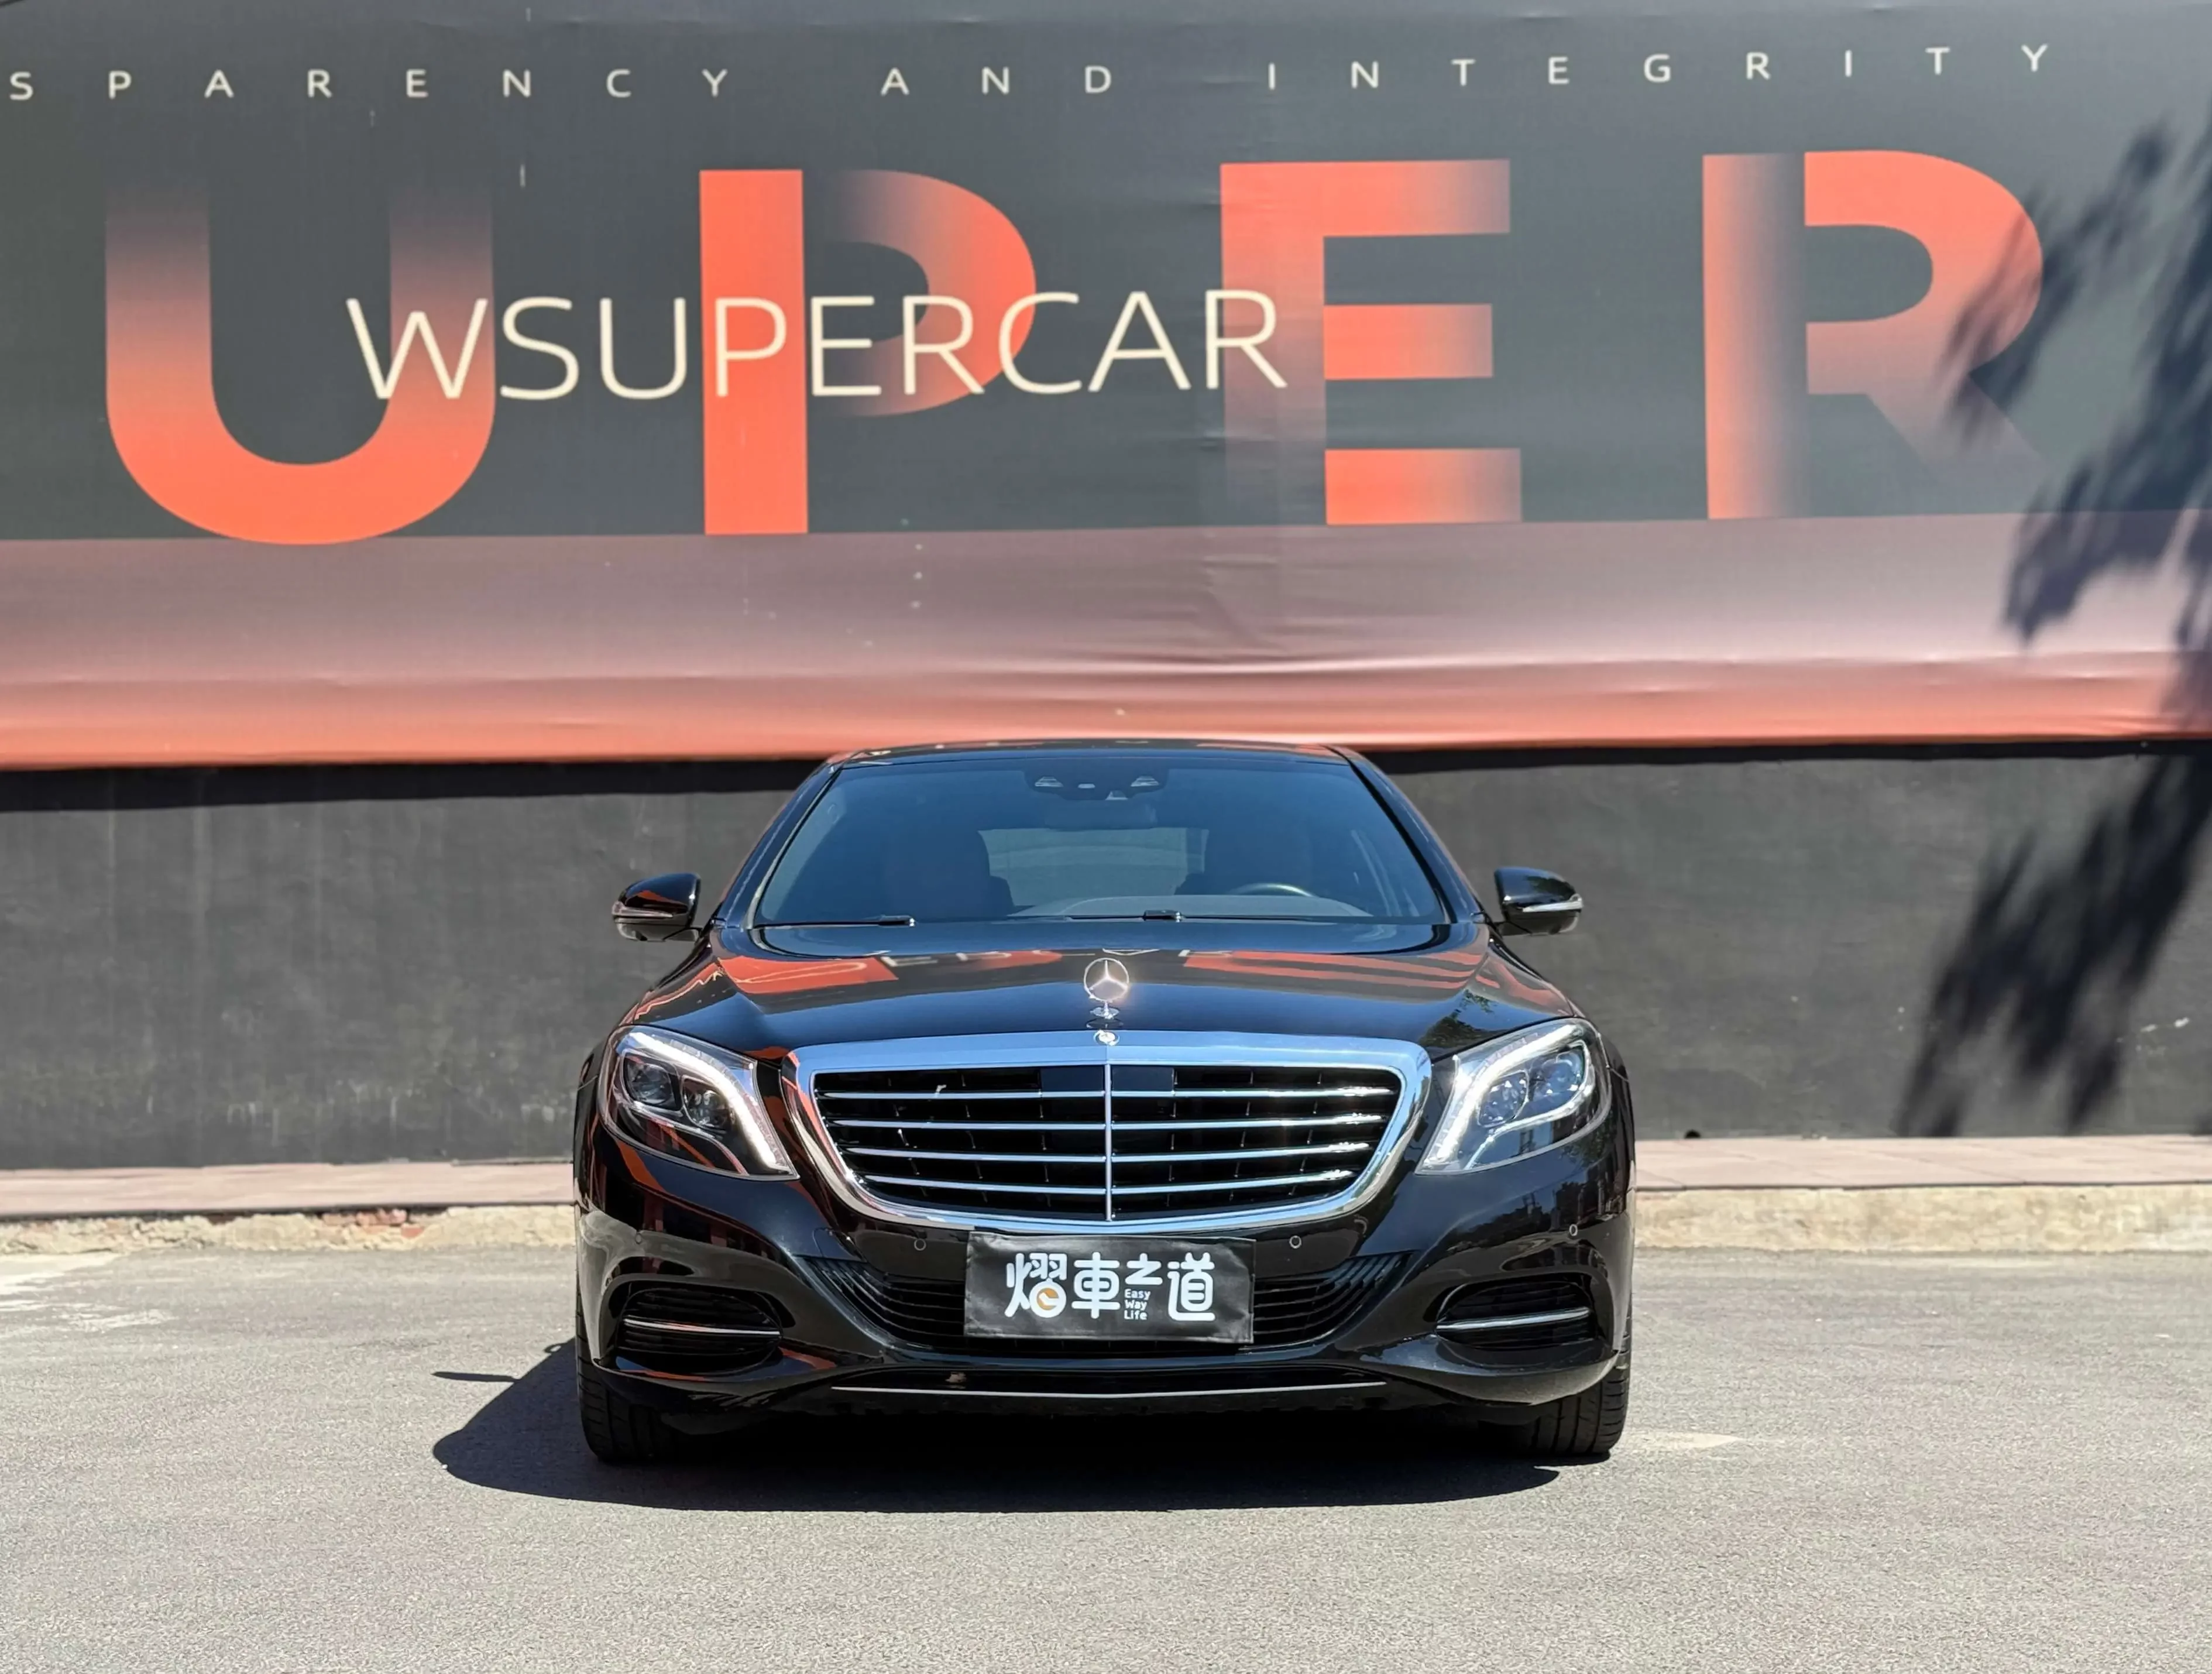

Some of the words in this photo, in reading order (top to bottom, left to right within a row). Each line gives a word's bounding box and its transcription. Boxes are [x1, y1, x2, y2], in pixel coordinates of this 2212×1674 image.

[880, 65, 1112, 96] AND
[1268, 43, 2049, 91] INTEGRITY
[346, 287, 1288, 402] WSUPERCAR
[1124, 1288, 1151, 1301] Easy
[1124, 1299, 1147, 1311] Way
[1124, 1310, 1148, 1320] Life
